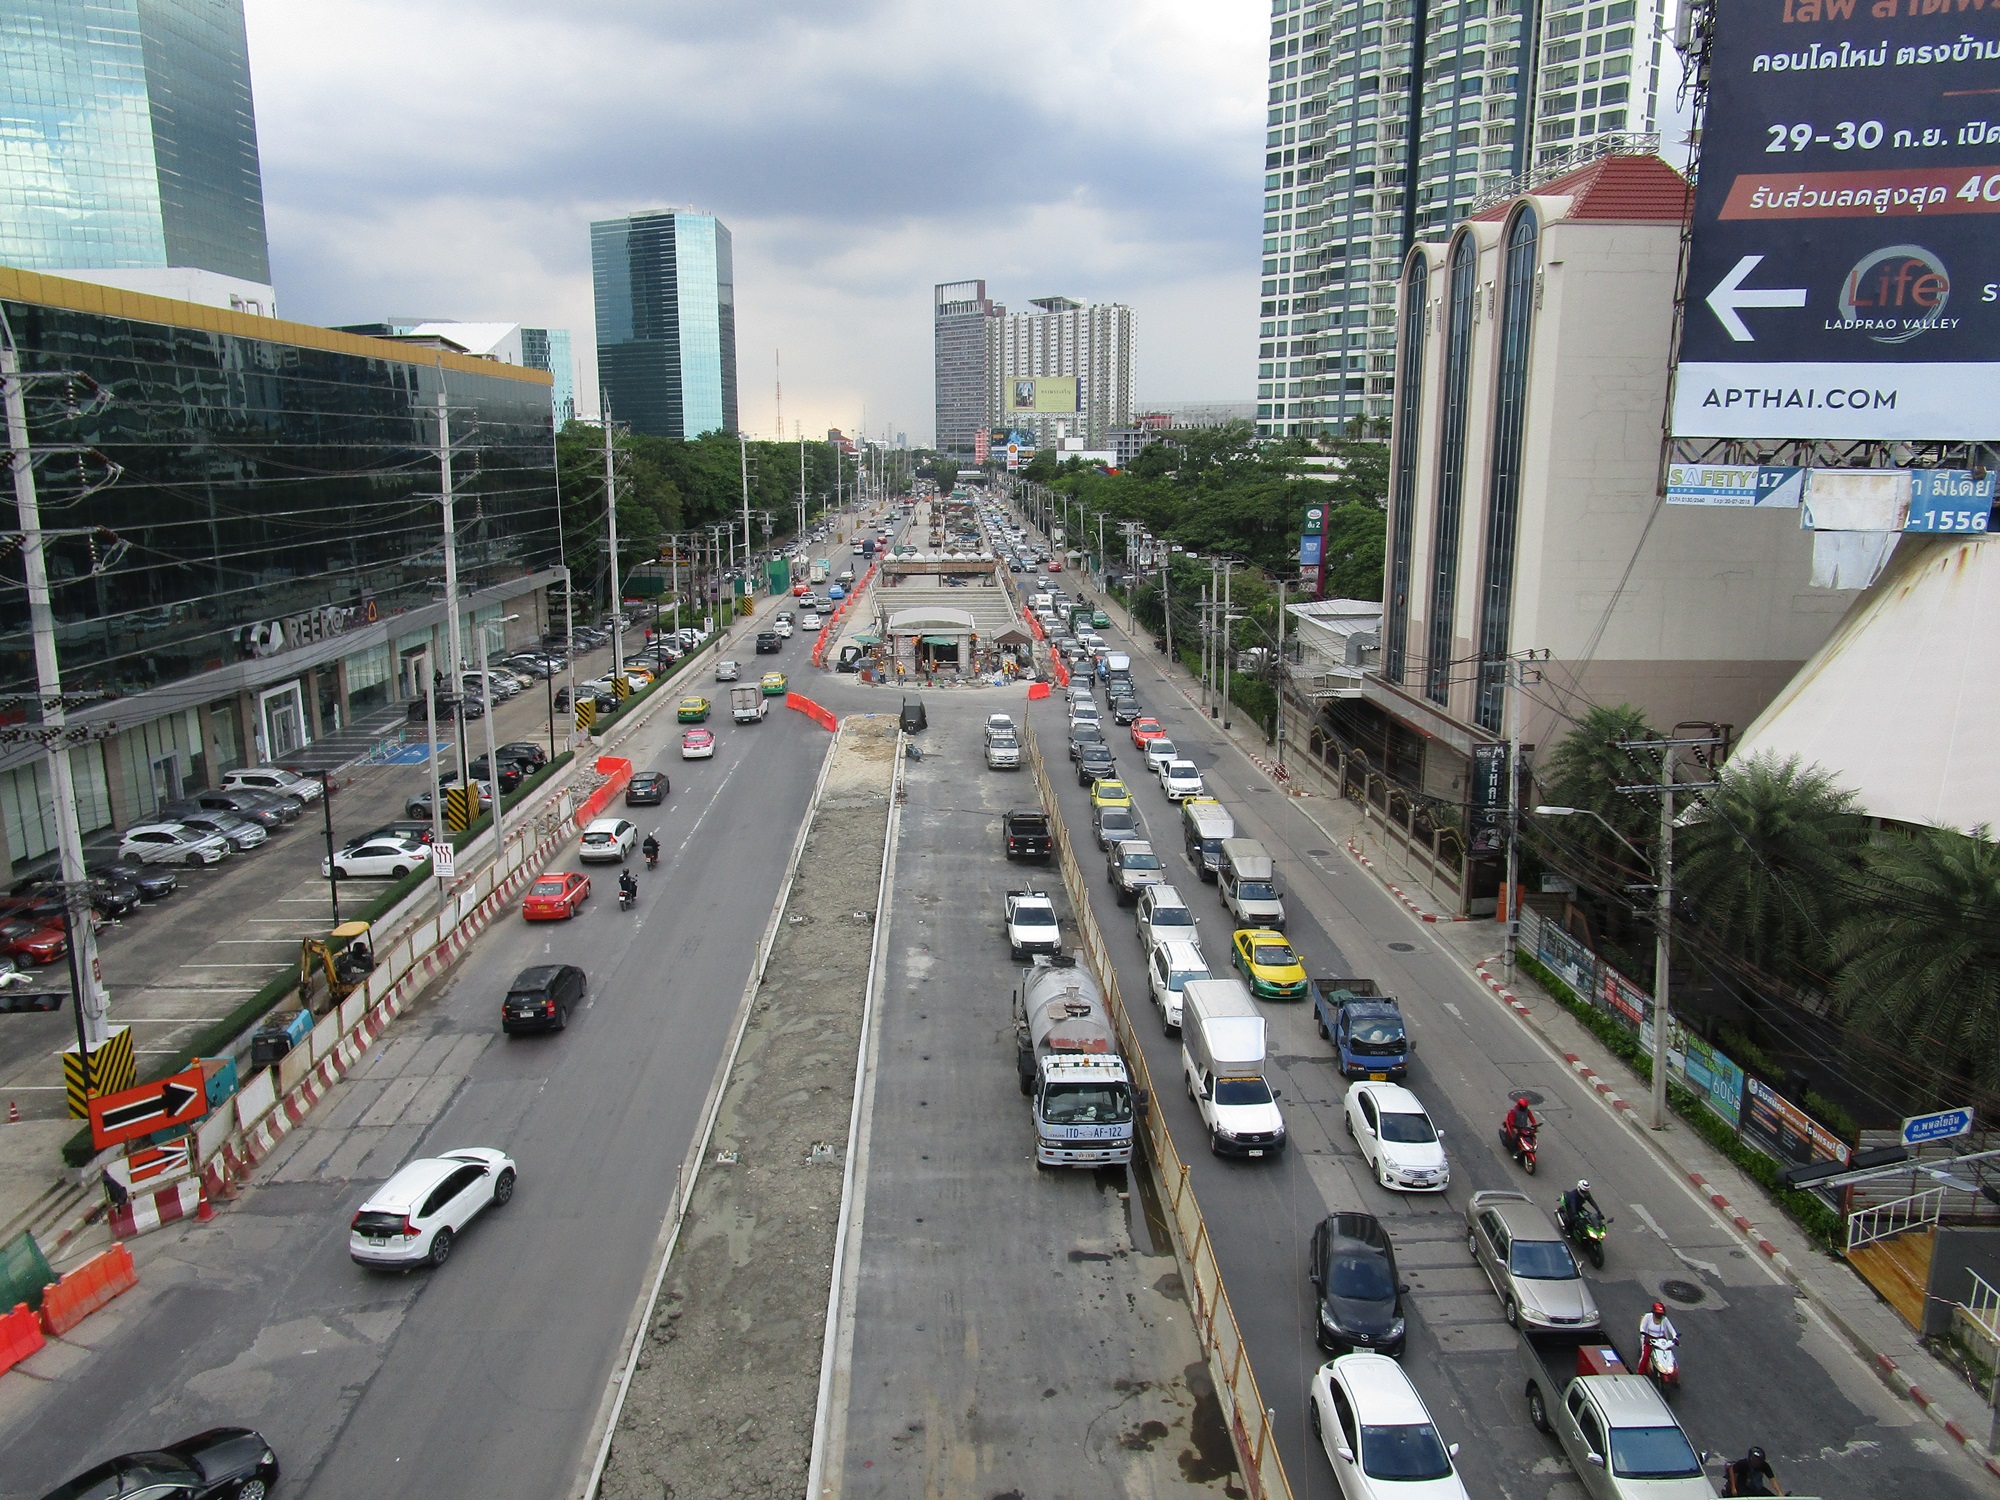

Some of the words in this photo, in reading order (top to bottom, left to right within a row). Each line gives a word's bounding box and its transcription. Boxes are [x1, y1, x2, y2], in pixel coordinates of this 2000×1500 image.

[1752, 41, 1888, 73] คอนโดใหม่
[1765, 121, 1884, 153] 29-30
[1893, 129, 1949, 148] ก.ย.
[1750, 184, 1948, 214] รับส่วนลดสูงสุด
[1847, 258, 1950, 307] Life
[1824, 318, 1898, 331] LADPRAO
[1902, 318, 1960, 330] VALLEY
[1702, 388, 1898, 410] APTHAI.COM
[1093, 1126, 1122, 1138] AF-122
